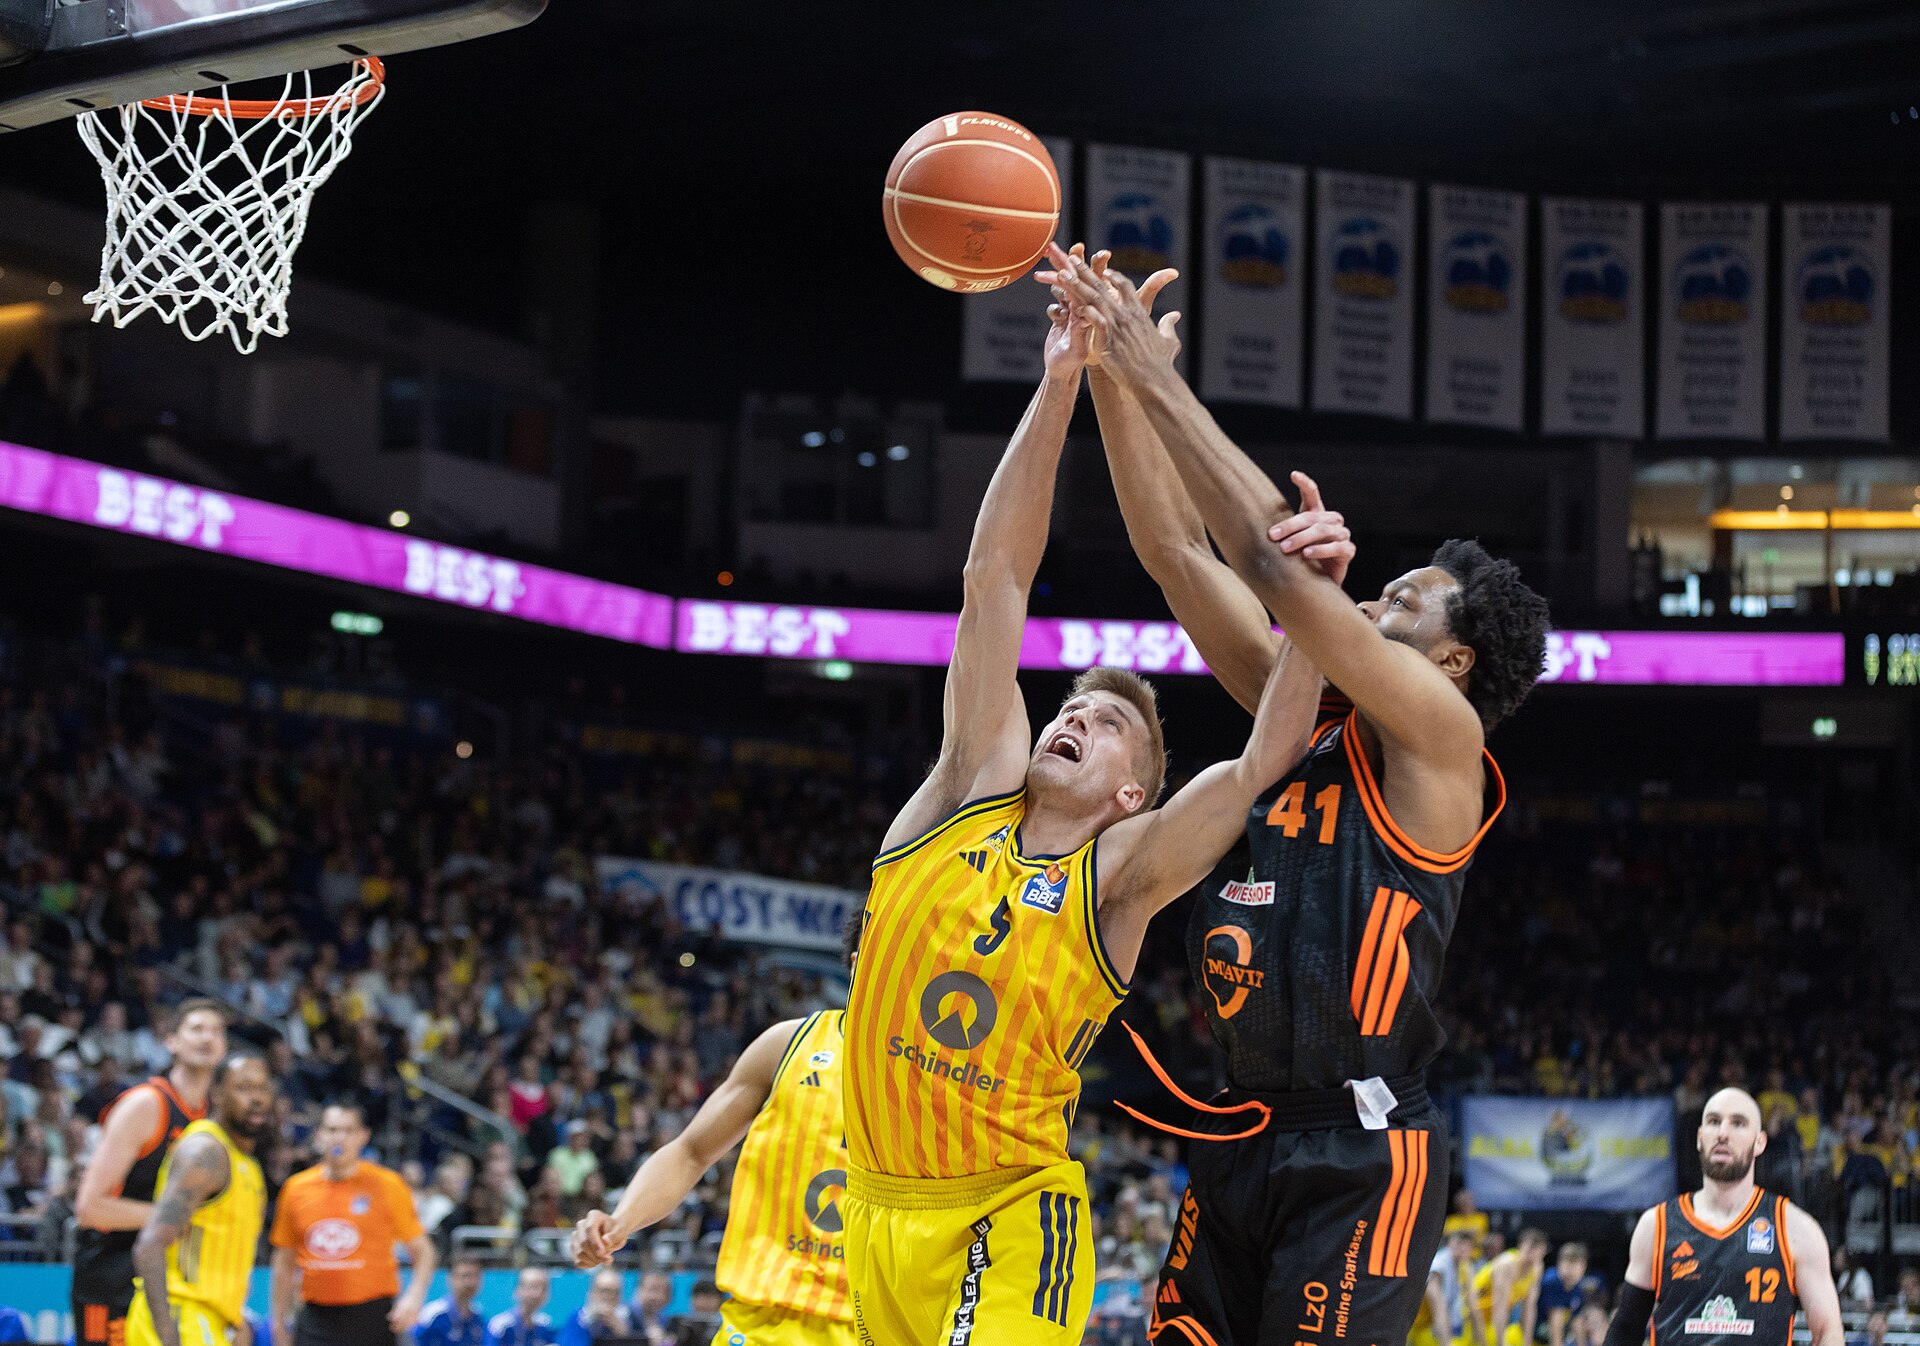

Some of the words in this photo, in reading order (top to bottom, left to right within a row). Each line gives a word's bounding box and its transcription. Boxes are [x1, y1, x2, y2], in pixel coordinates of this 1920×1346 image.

[960, 118, 1031, 141] PLAYOFFS
[95, 469, 236, 548] BEST
[404, 540, 525, 612] BEST
[689, 602, 849, 657] BEST
[1266, 781, 1342, 845] 41
[973, 895, 1011, 956] 5
[1025, 888, 1056, 909] BBL
[887, 1035, 1005, 1093] Schindler
[787, 1234, 845, 1259] Schind
[1168, 1179, 1200, 1271] VILS
[1340, 1219, 1369, 1292] Sparkasse
[1298, 1281, 1329, 1333] LzO
[1744, 1266, 1781, 1304] 12
[1335, 1292, 1353, 1338] meine
